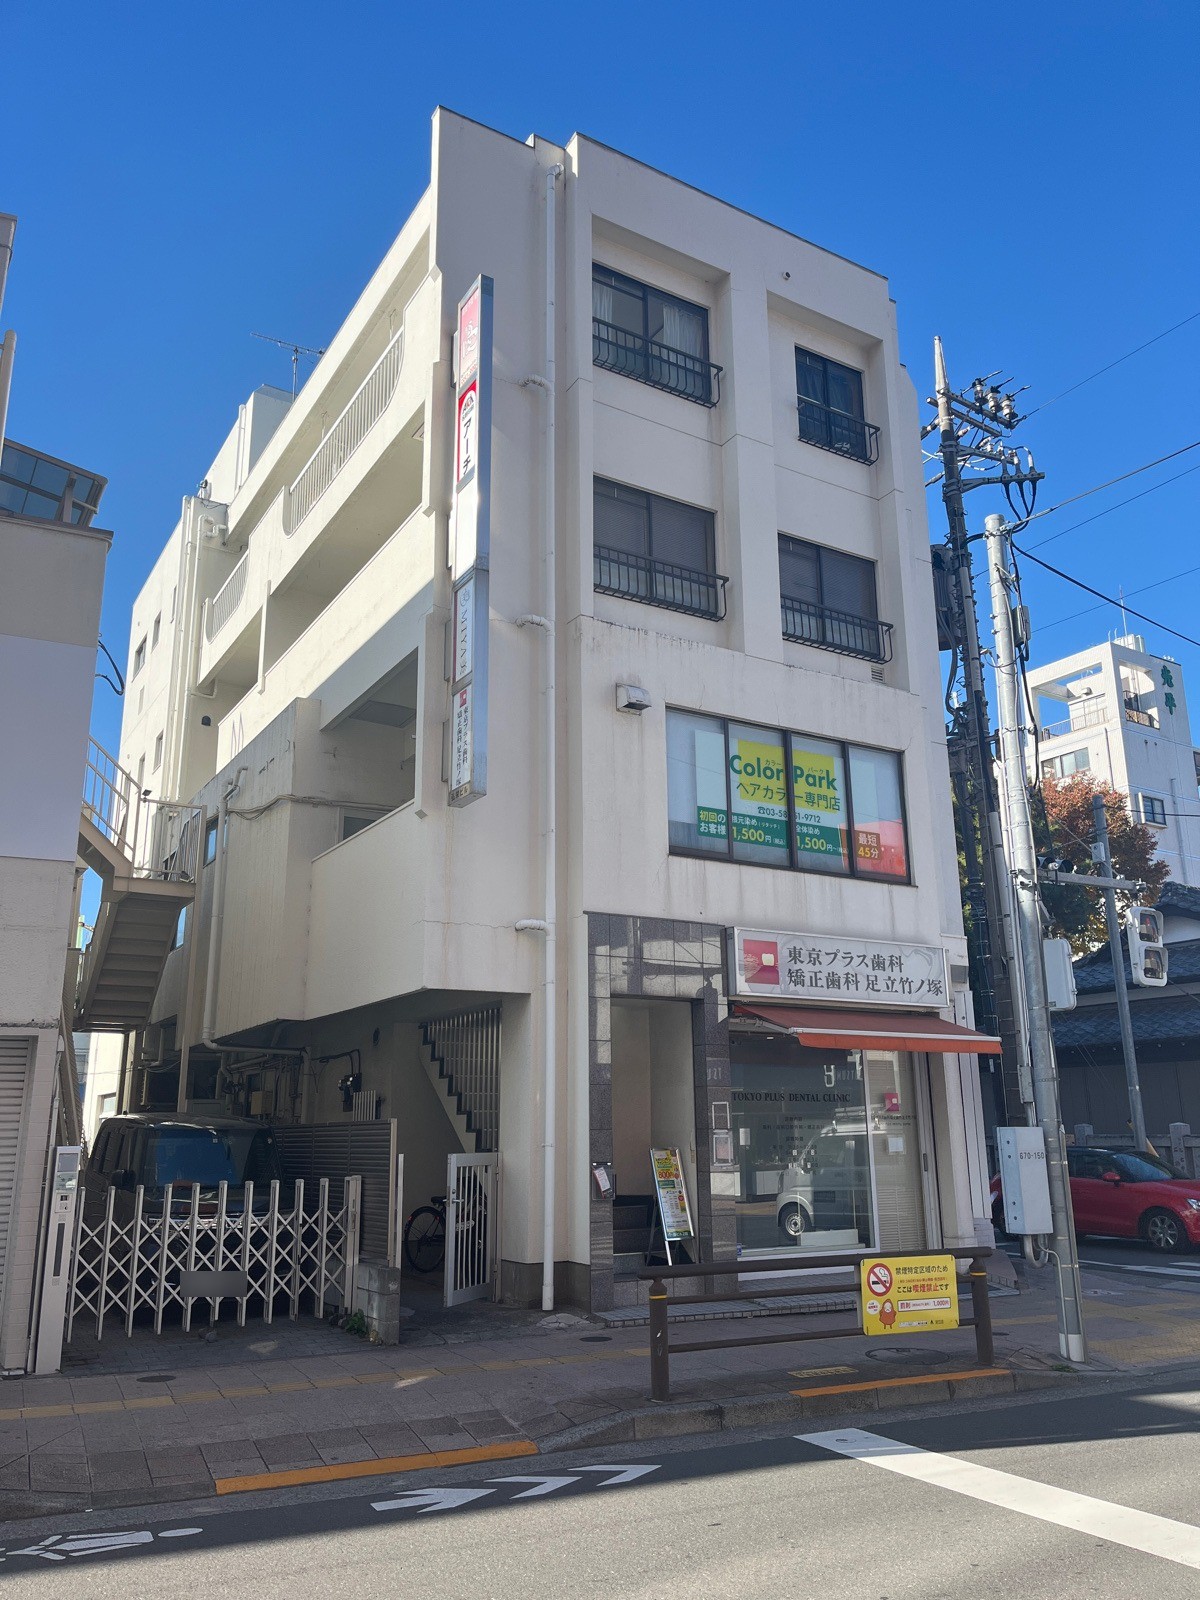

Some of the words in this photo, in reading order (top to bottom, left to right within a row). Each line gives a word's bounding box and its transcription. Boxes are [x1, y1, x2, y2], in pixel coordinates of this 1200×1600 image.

[463, 417, 471, 475] アーチ
[729, 754, 784, 781] Color
[793, 765, 838, 791] Park
[736, 782, 841, 812] ヘアカラー専門店
[700, 810, 726, 823] 初回の
[700, 822, 727, 835] お客様
[796, 825, 821, 836] 全体染め
[858, 832, 878, 847] 最短
[858, 846, 879, 859] 45分
[786, 946, 904, 974] 東京プラス歯科
[786, 968, 861, 992] 矯正歯科
[865, 974, 944, 997] 足立竹ノ塚
[732, 1092, 762, 1102] TOKYO
[764, 1092, 786, 1102] PLUS
[789, 1092, 820, 1103] DENTAL
[822, 1093, 851, 1103] CLINIC
[895, 1264, 949, 1275] 禁煙特定区域のため
[897, 1283, 950, 1294] ここは喫煙禁止です
